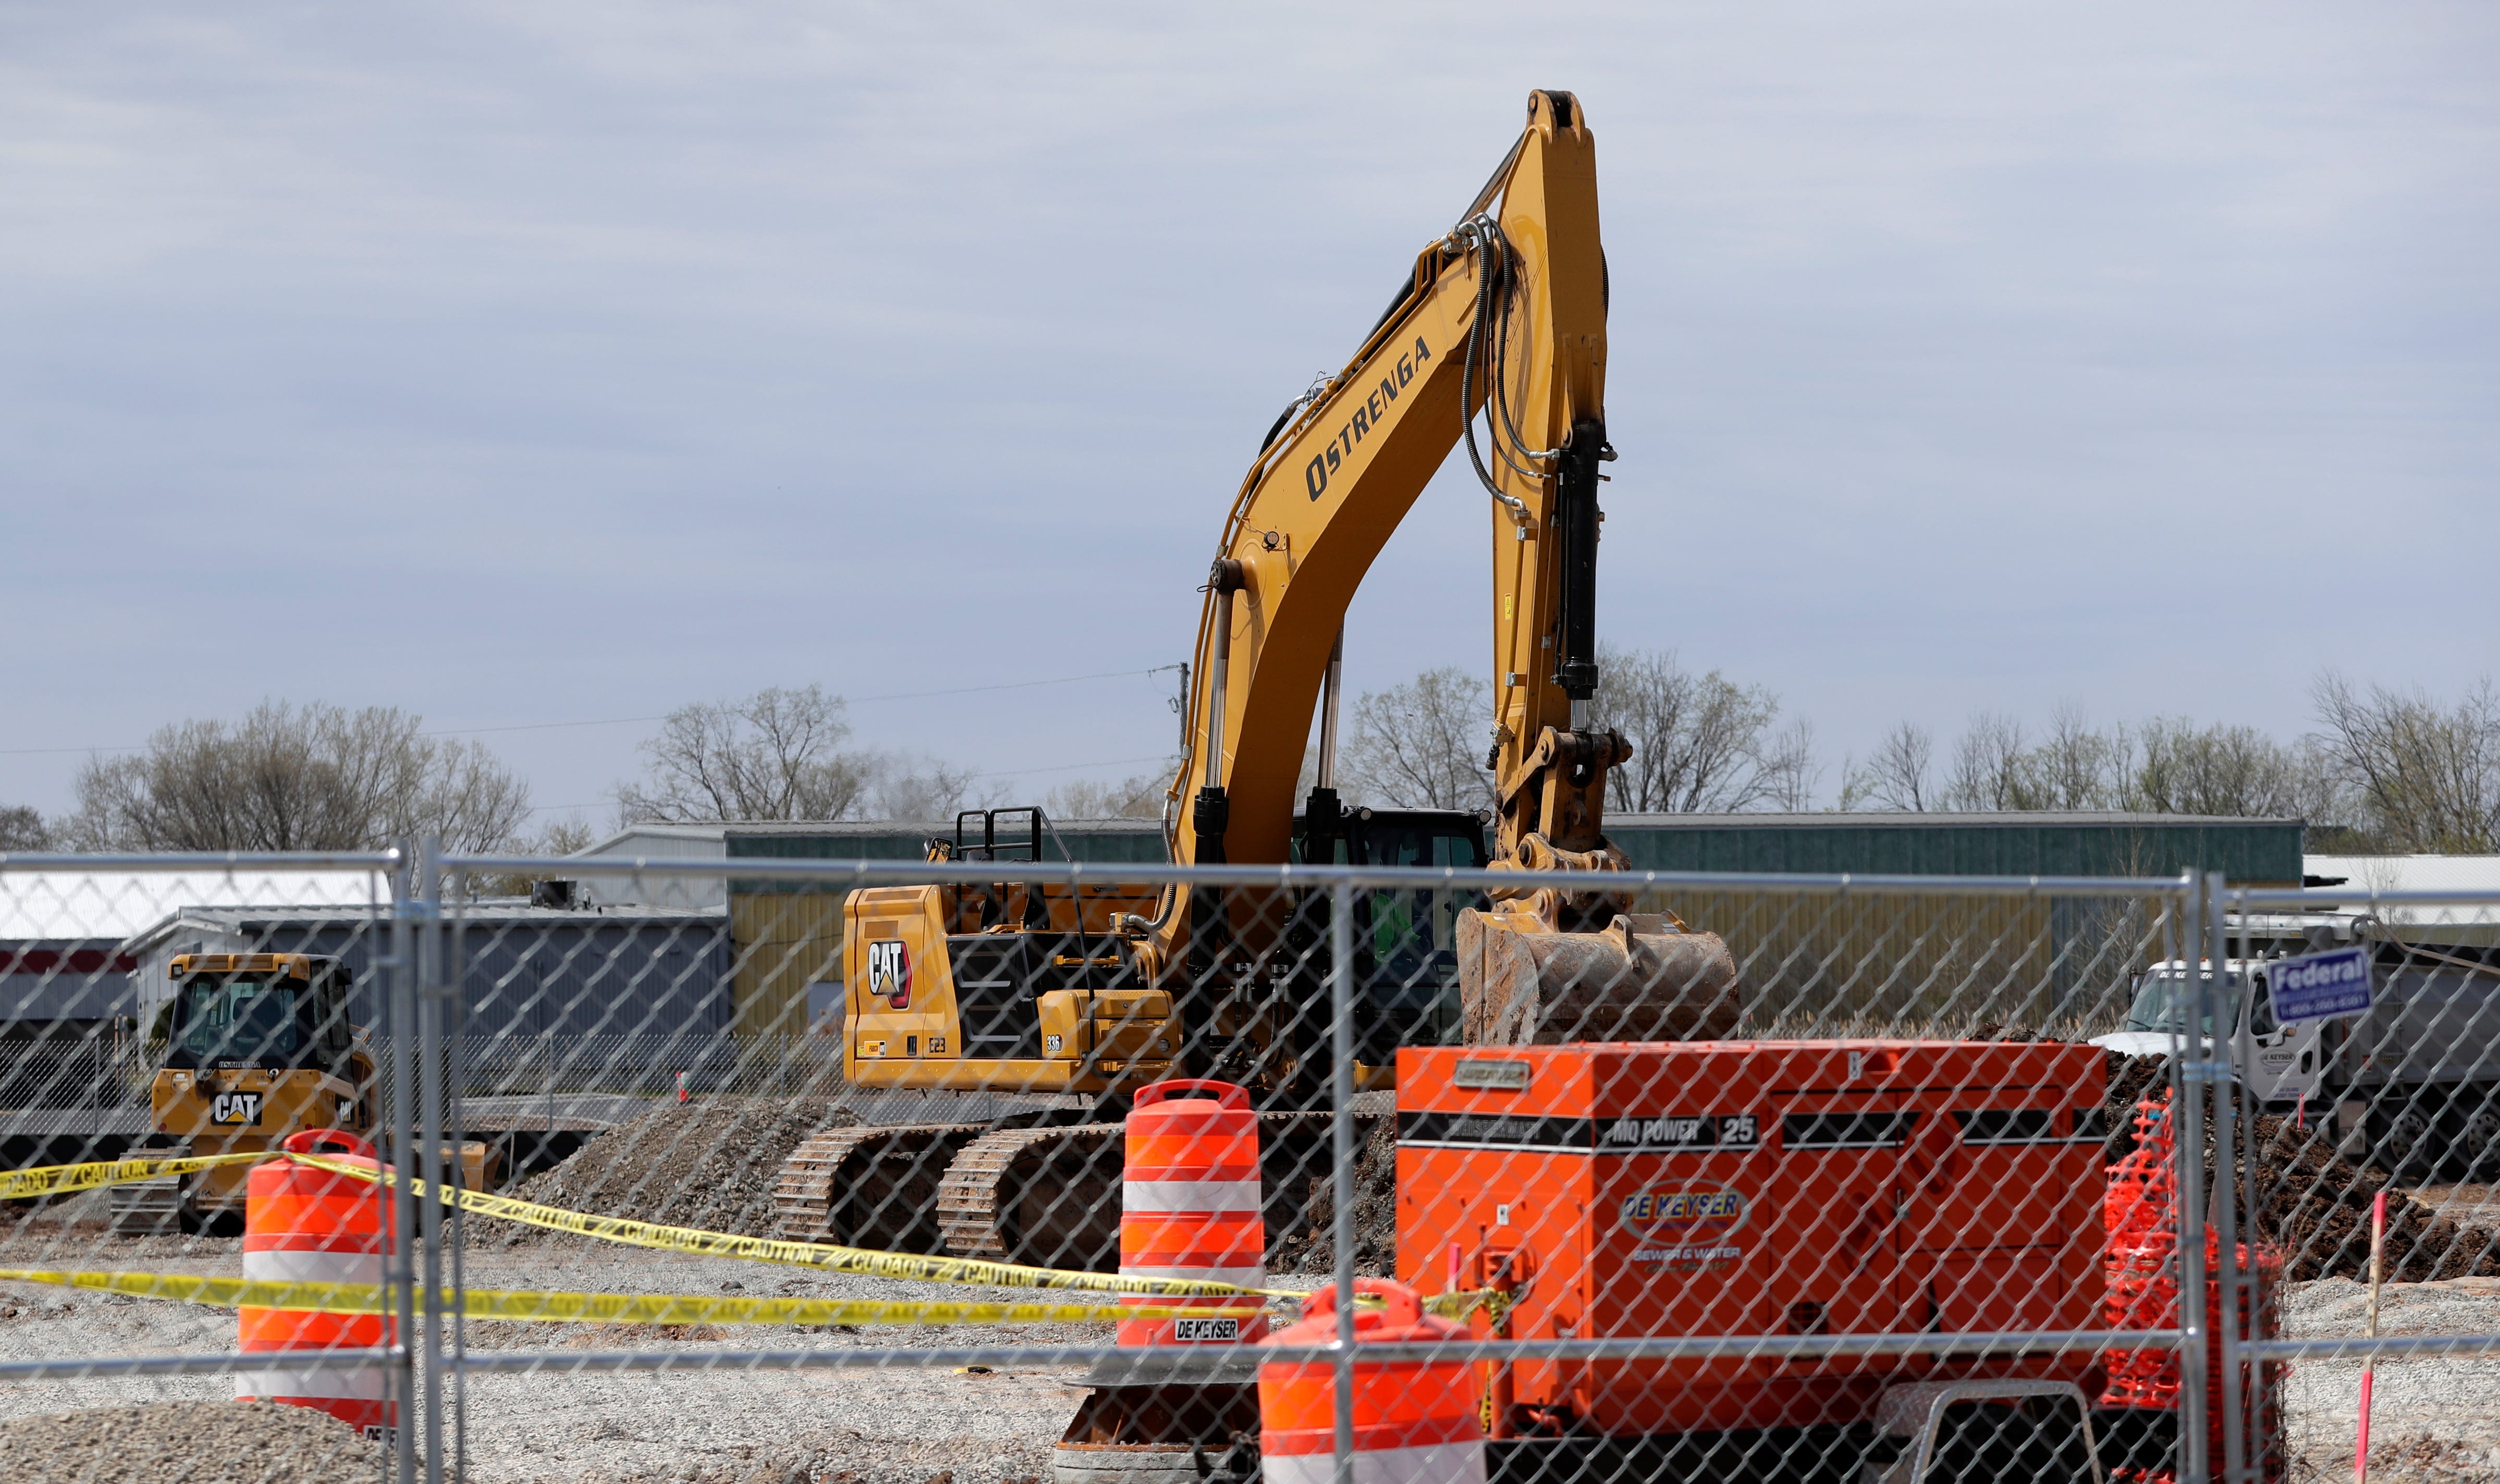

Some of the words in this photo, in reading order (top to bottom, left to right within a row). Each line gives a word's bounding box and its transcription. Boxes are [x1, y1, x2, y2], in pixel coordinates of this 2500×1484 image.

[1305, 335, 1431, 502] OSTRENGA
[868, 943, 901, 994] CAT
[2273, 955, 2364, 991] Federal
[929, 1037, 946, 1053] E23
[1047, 1035, 1059, 1050] 336
[215, 1095, 256, 1122] CAT
[340, 1101, 351, 1121] CAT
[1612, 1120, 1640, 1143] MQ
[1643, 1119, 1698, 1142] POWER
[1724, 1118, 1755, 1143] 25
[1623, 1194, 1653, 1220] DE
[1655, 1192, 1738, 1219] KEYSER
[509, 1203, 586, 1230] CAUTION
[626, 1222, 702, 1246] CUIDADO
[737, 1240, 815, 1264] CAUTION
[851, 1252, 928, 1277] CUIDADO
[967, 1264, 1037, 1288] CAUTION
[1634, 1249, 1681, 1261] SEWER
[1682, 1248, 1692, 1259] &
[1694, 1247, 1742, 1260] WATER
[1177, 1320, 1194, 1339] DE
[1194, 1320, 1236, 1339] KEYSER
